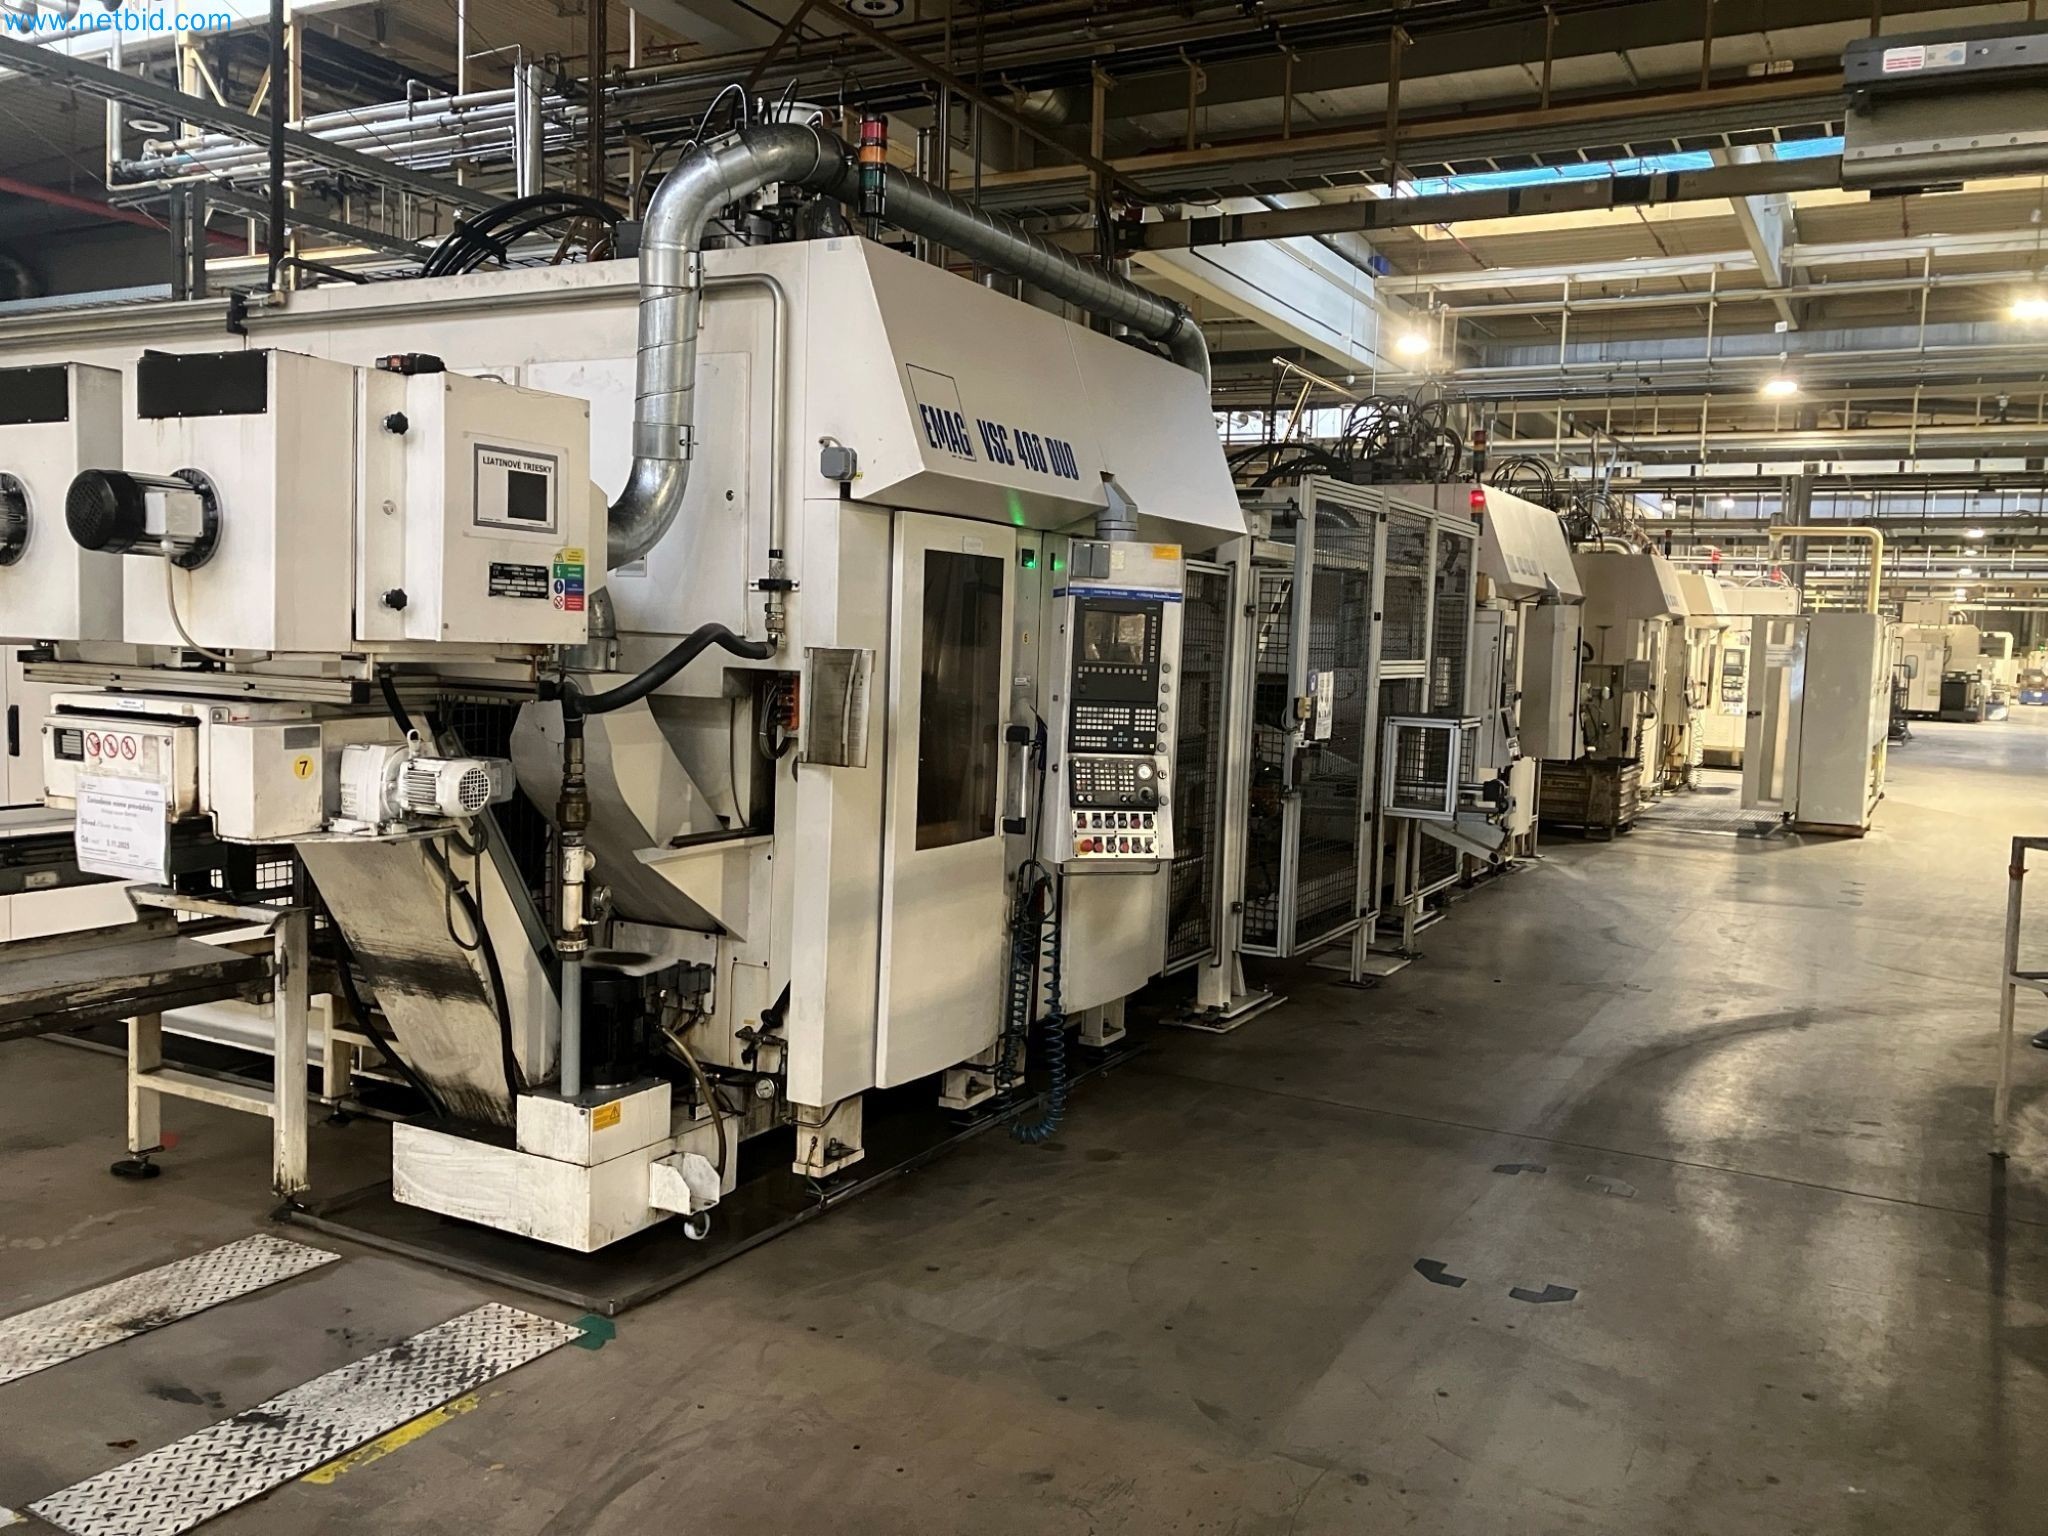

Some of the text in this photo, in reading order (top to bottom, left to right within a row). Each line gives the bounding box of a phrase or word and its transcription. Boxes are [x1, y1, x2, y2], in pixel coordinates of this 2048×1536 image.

[919, 403, 1080, 481] EMAG VSC 400 DUO
[482, 456, 552, 473] LIATINOVÉ TRIESKY
[299, 760, 308, 776] 7
